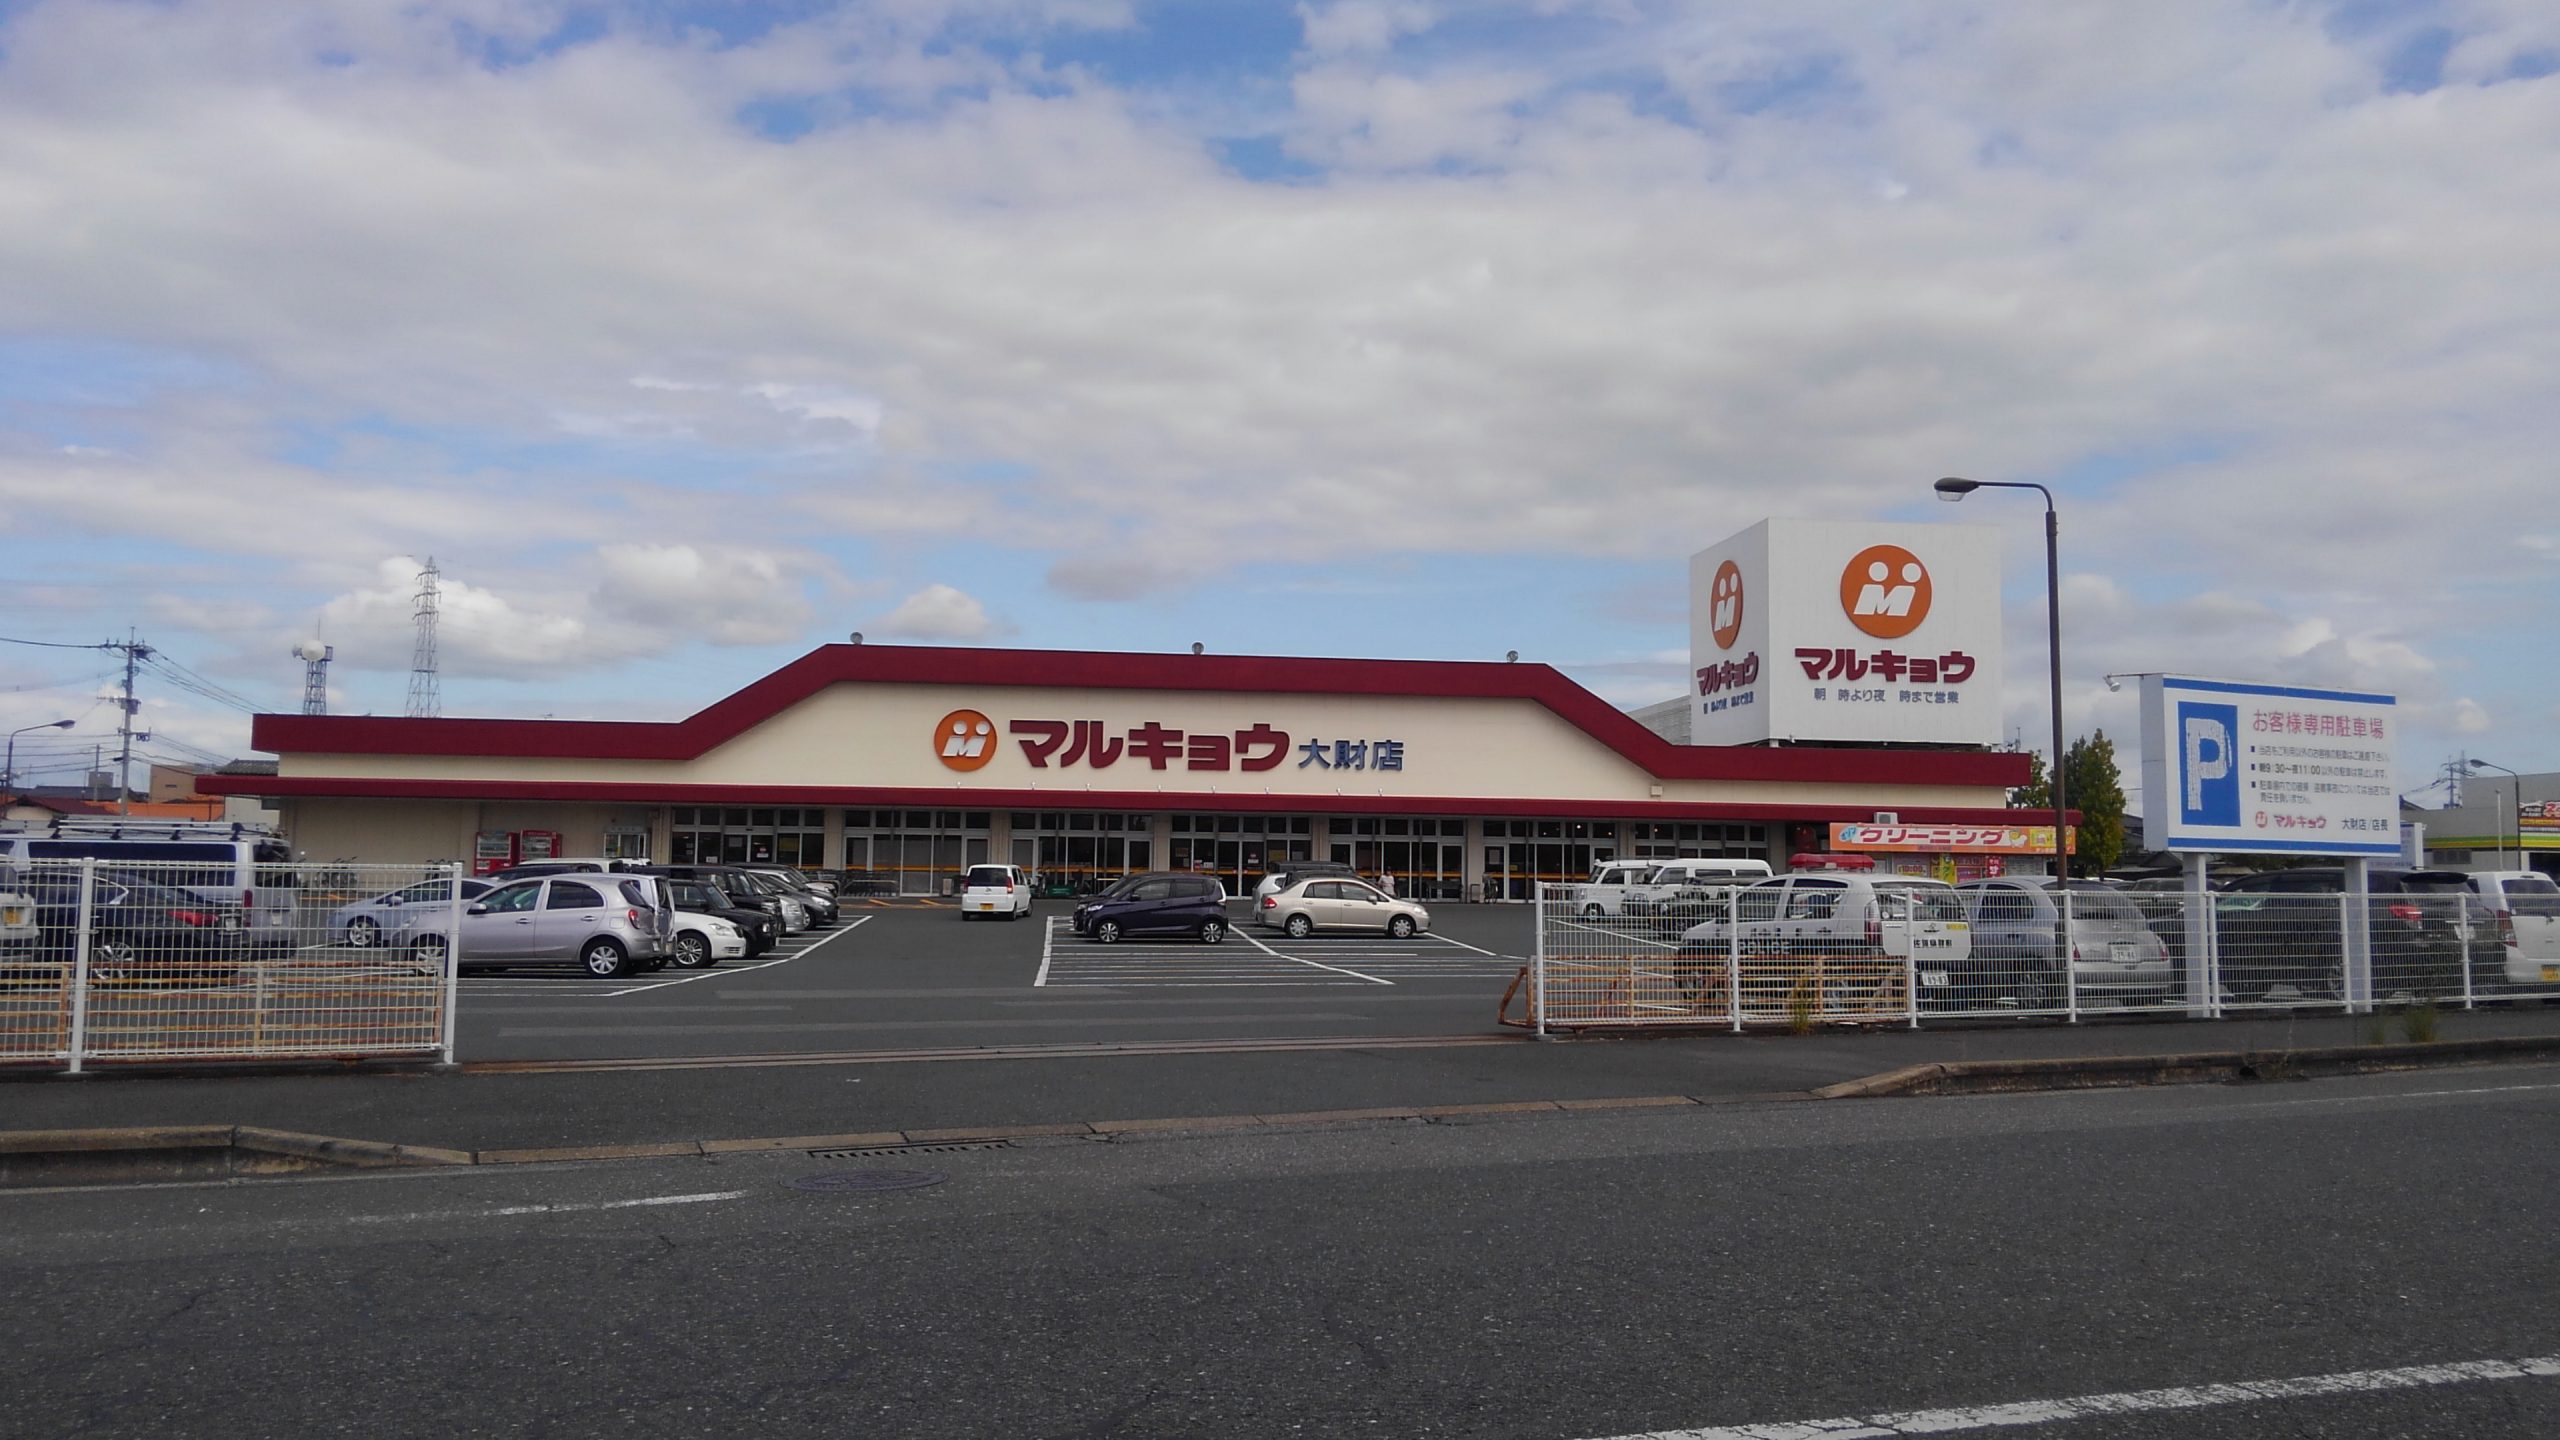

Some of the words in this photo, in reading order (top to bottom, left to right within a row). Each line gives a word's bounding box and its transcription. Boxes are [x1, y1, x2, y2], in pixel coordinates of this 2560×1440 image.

[1696, 651, 1759, 696] マルキョウ
[1794, 648, 1976, 684] マルキョウ
[1814, 688, 1826, 701] 朝
[1838, 688, 1886, 702] 時より夜
[1899, 689, 1960, 704] 時まで営業
[2253, 709, 2384, 740] お客様専用駐車場
[1009, 719, 1291, 772] マルキョウ
[1297, 738, 1405, 772] 大財店
[2274, 814, 2327, 829] マルキョウ
[1860, 829, 2003, 845] クリーニング
[1739, 941, 1790, 955] POLICE
